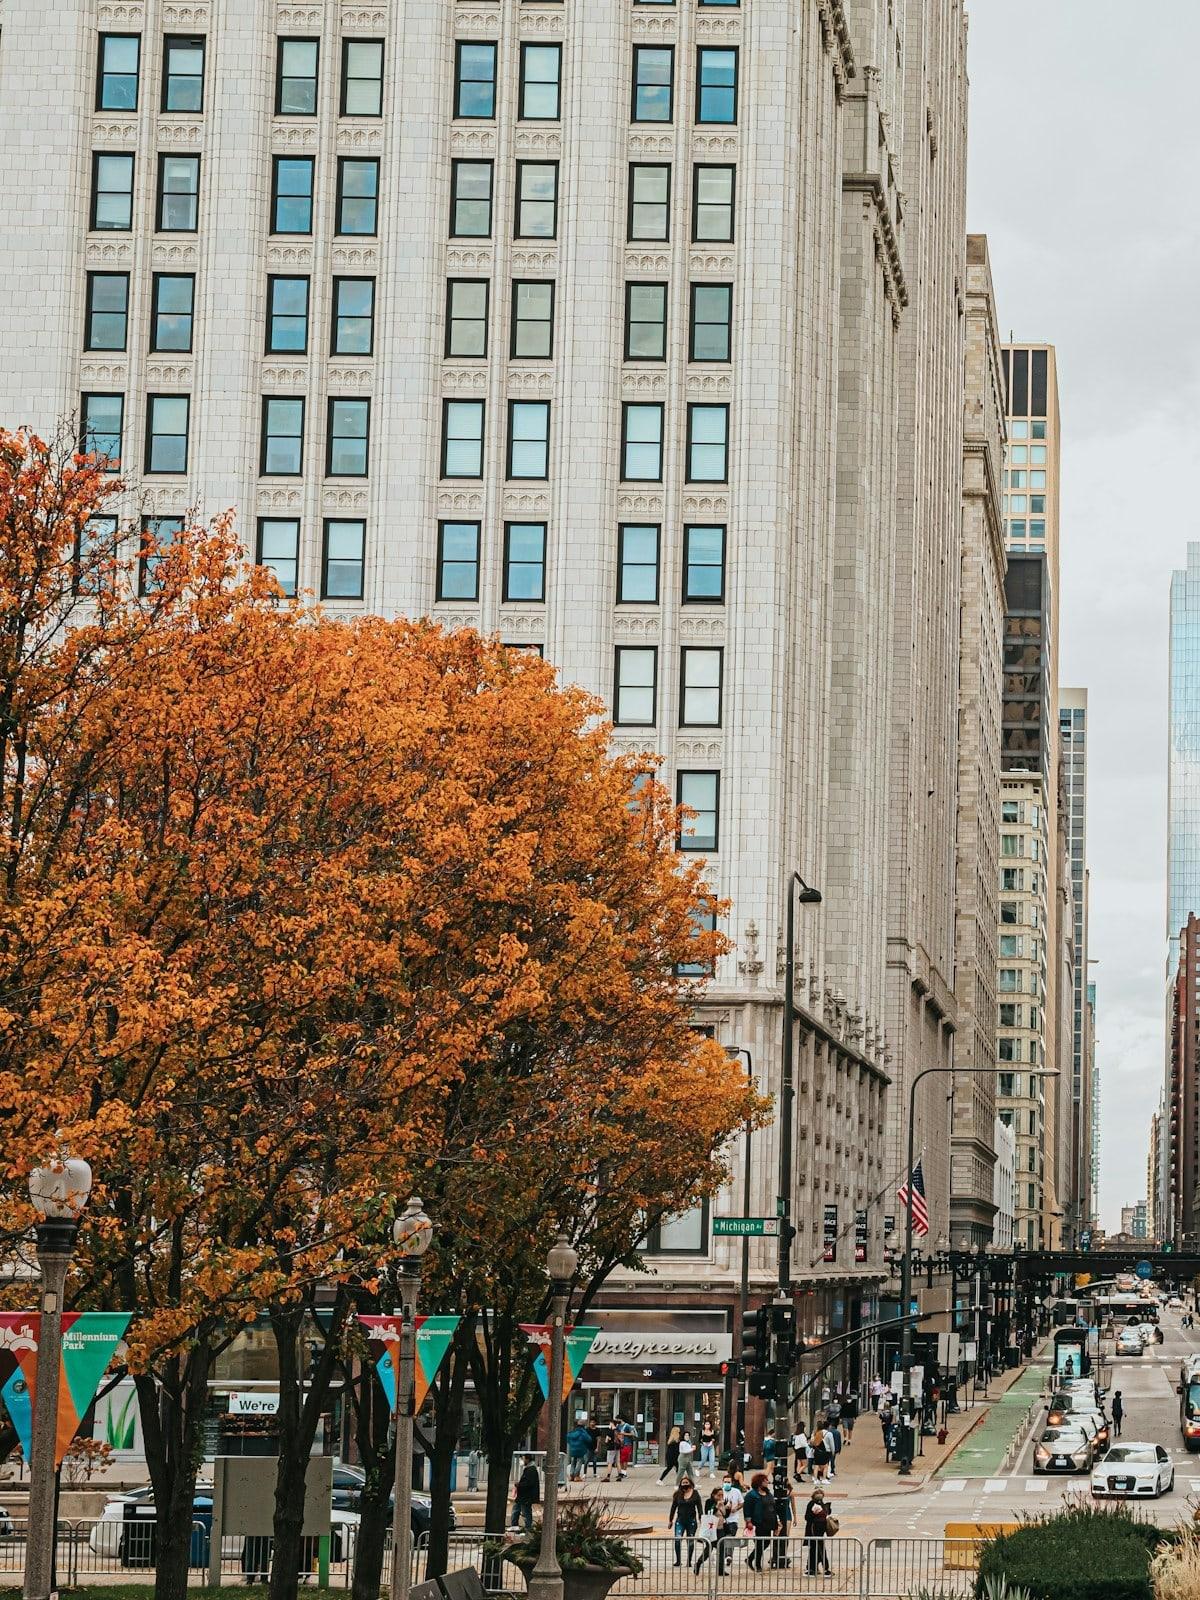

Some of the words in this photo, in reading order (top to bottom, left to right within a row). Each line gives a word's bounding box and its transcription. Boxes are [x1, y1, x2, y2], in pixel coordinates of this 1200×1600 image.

[720, 1221, 755, 1233] Michigan
[63, 1332, 118, 1341] Millennium
[63, 1341, 85, 1349] Park
[239, 1400, 275, 1411] We're
